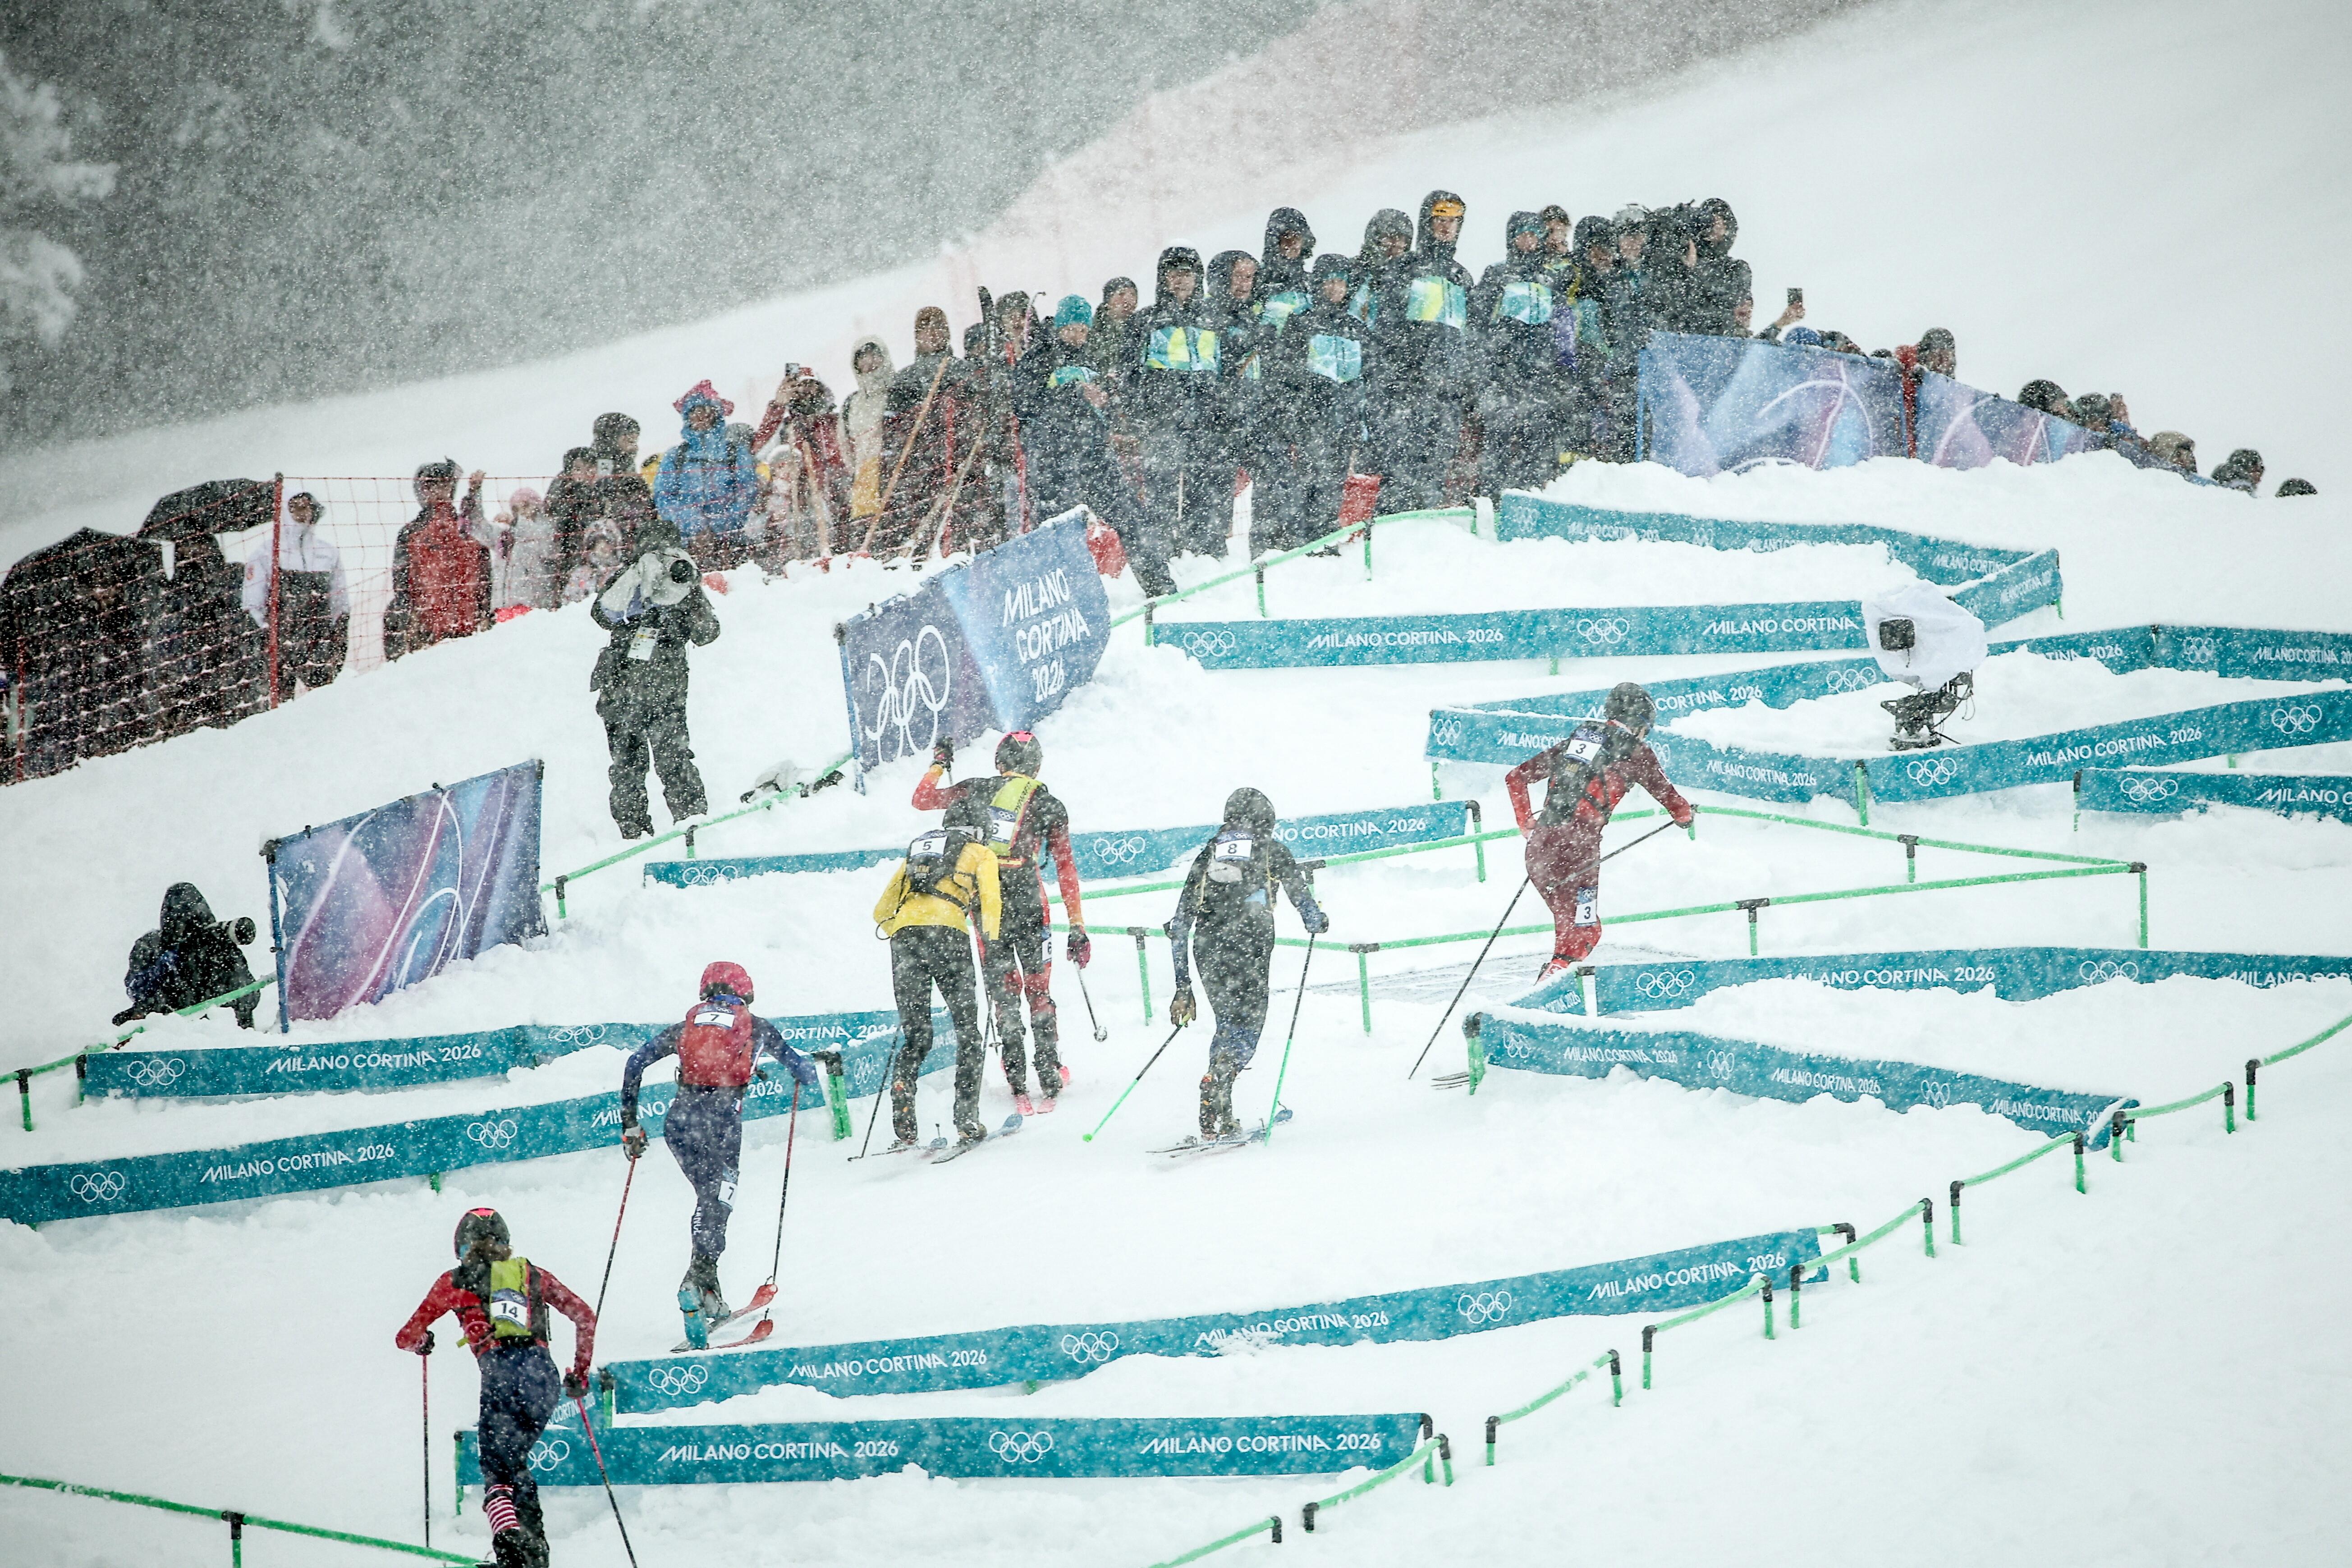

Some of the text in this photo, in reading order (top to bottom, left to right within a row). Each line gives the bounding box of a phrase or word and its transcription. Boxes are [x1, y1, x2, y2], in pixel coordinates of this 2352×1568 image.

[1003, 568, 1070, 627] MILANO
[1016, 607, 1091, 664] CORTINA
[1702, 616, 1859, 635] MILANO CORTINA
[1307, 628, 1504, 648] MILANO CORTINA 2026
[2089, 644, 2123, 660] 2026
[2255, 647, 2352, 665] MILANO CORTINA 20
[1032, 657, 1064, 703] 2026
[1655, 686, 1762, 711] CORTINA 2026
[1498, 730, 1540, 749] MILANO
[1576, 743, 1586, 754] 3
[2026, 726, 2202, 767] MILANO CORTINA 2026
[1706, 760, 1817, 786] MILANO CORTINA 2026
[2256, 788, 2338, 804] MILANO
[992, 823, 999, 834] 6
[1302, 821, 1383, 839] CORTINA
[1387, 817, 1426, 834] 2026
[922, 841, 932, 851] 5
[1228, 843, 1238, 854] 8
[1584, 906, 1591, 920] 3
[1863, 968, 1949, 984] CORTINA
[1954, 966, 1995, 982] 2026
[711, 1013, 720, 1022] 7
[781, 1025, 852, 1041] ORTINA
[266, 1044, 481, 1073] MILANO CORTINA 2026
[1564, 1046, 1678, 1064] MILANO CORTINA 2026
[1771, 1068, 1881, 1094] MILANO CORTINA 2026
[591, 1100, 665, 1128] MILNO
[747, 1081, 784, 1099] 2026
[1985, 1099, 2102, 1125] MILANO CORTINA 20
[200, 1143, 394, 1183] MILANO CORTINA 2026
[728, 1186, 734, 1200] 7
[1586, 1253, 1786, 1301] MILANO CORTINA 2026
[501, 1302, 518, 1318] 14
[1274, 1313, 1351, 1334] CORTINA
[1353, 1311, 1389, 1329] 2026
[788, 1350, 987, 1379] MILANO CORTINA 2026
[658, 1440, 899, 1462] MILANO CORTINA 2026
[1141, 1433, 1381, 1454] MILANO CORTINA 2026
